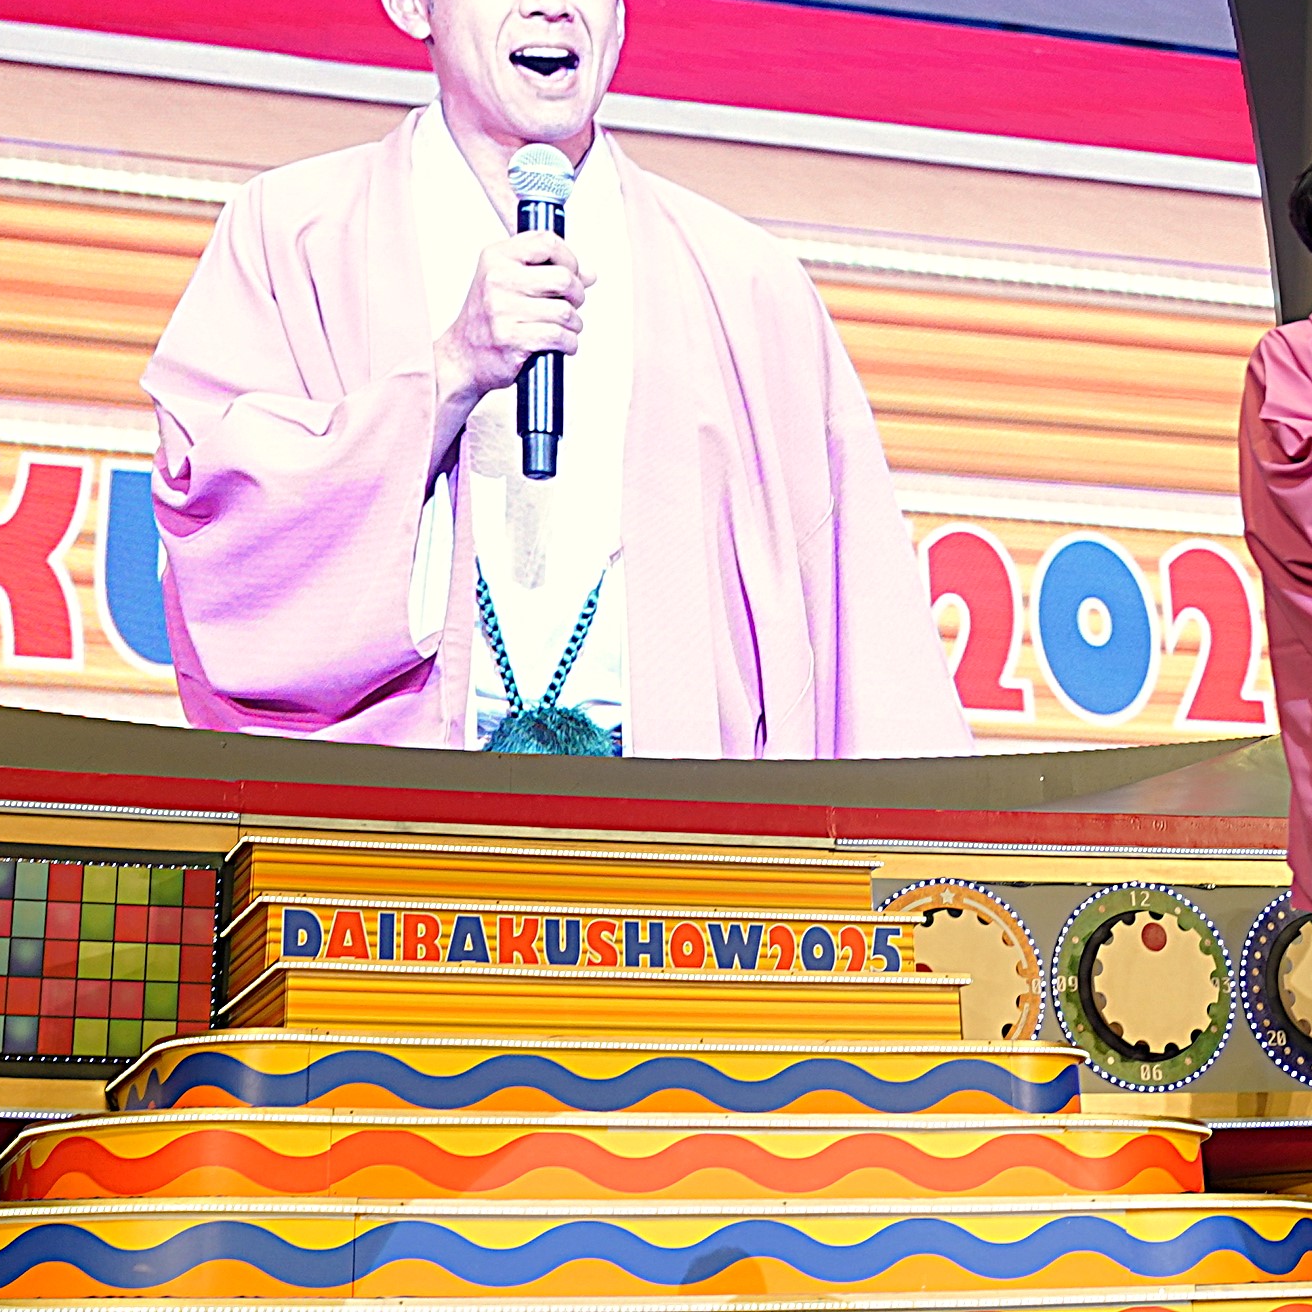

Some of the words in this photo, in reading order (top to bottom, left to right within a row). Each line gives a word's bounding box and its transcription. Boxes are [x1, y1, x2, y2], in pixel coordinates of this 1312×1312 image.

[1130, 890, 1151, 907] 12
[282, 907, 902, 973] DAIBAKUSHOW2025
[1057, 975, 1078, 992] 09
[1267, 1030, 1287, 1047] 20
[1140, 1064, 1163, 1080] 06
